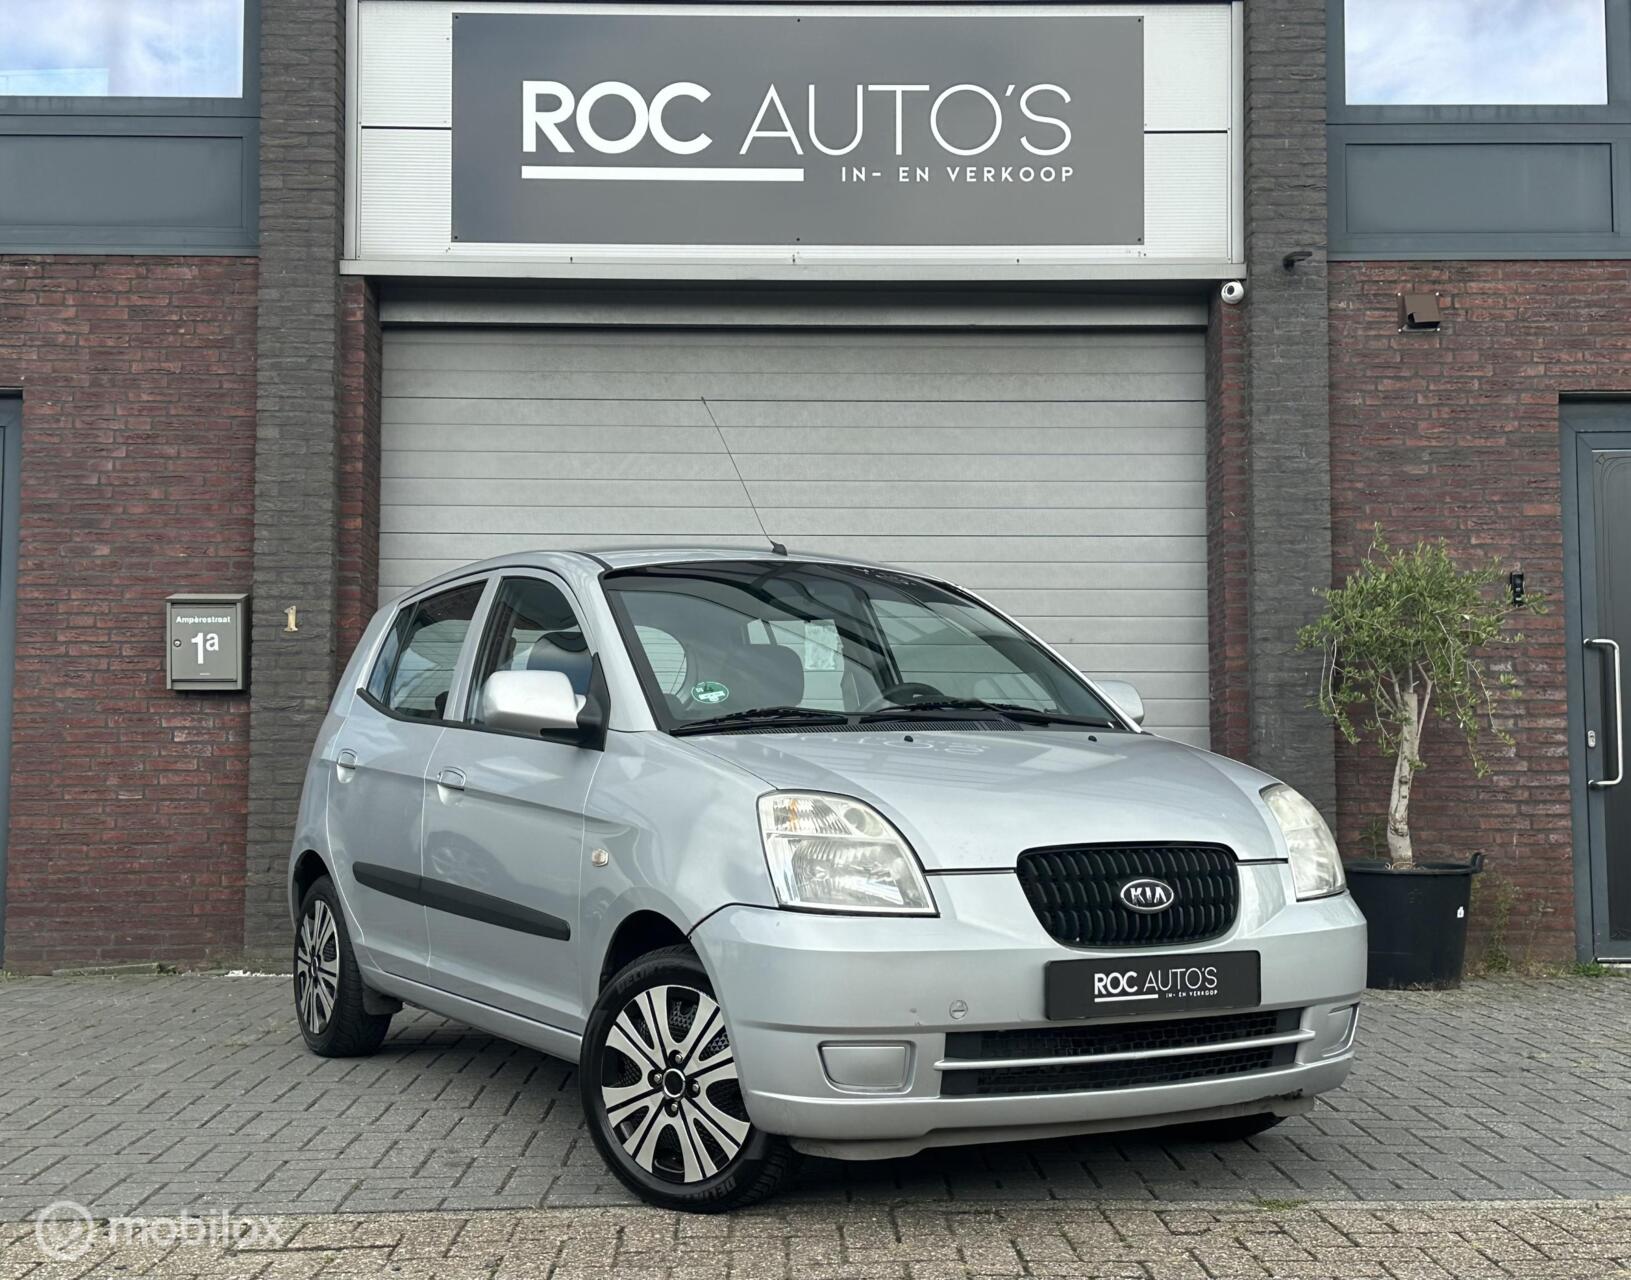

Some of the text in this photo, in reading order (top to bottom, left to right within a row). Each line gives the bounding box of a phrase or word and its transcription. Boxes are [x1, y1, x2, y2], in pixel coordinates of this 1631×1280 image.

[522, 80, 1073, 156] ROC AUTO'S
[841, 166, 1074, 183] IN- EN VERKOOP
[284, 605, 299, 632] 1
[191, 632, 219, 665] 1a
[1131, 886, 1167, 904] KIA
[1094, 967, 1218, 995] ROC AUTO'S
